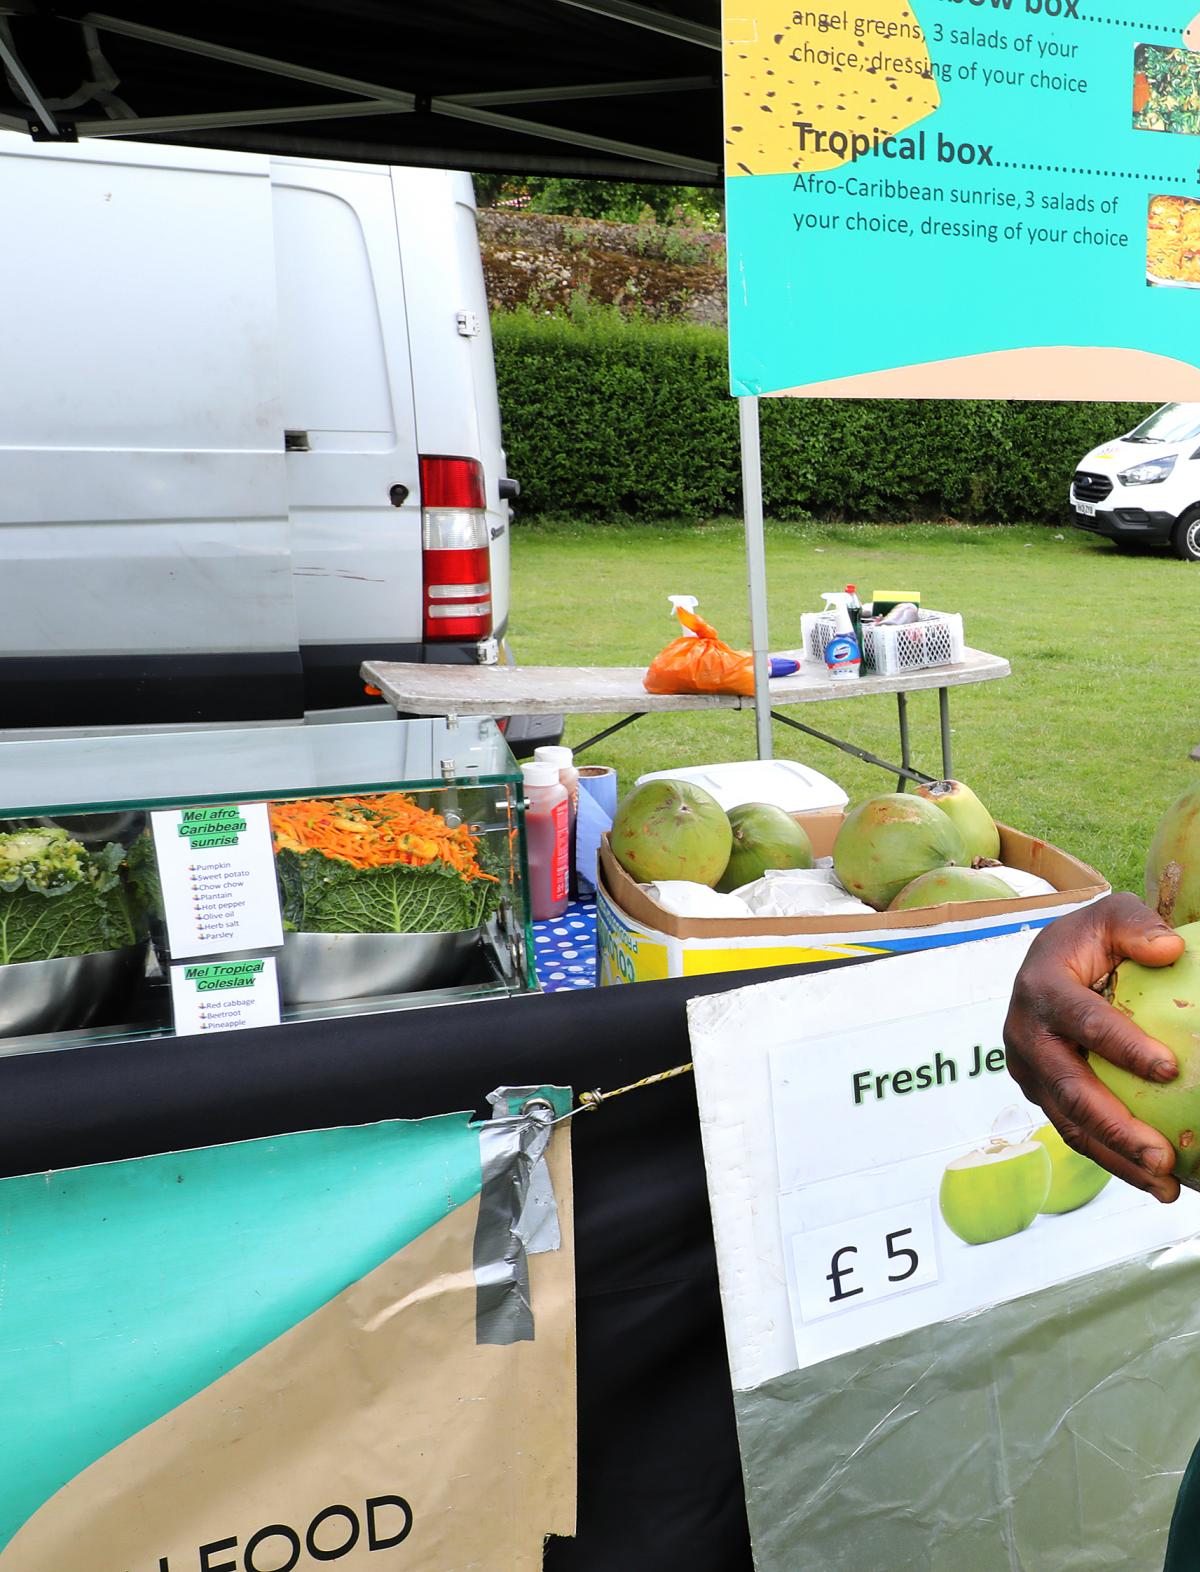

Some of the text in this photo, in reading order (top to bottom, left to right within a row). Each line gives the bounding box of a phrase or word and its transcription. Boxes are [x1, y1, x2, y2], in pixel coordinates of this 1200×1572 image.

[792, 10, 1078, 59] angel greens, 3 salads of your
[792, 43, 1087, 93] choice, dressing of your choice
[792, 122, 925, 163] Tropical
[793, 174, 1118, 214] Afro-Caribbean sunrise, 3 salads of
[793, 211, 1128, 247] your choice, dressing of your choice
[183, 810, 207, 822] Mel
[179, 821, 247, 836] Caribbean
[190, 835, 239, 848] sunrise
[196, 862, 231, 871] Pumpkin
[197, 870, 250, 881] Sweet potato
[199, 883, 221, 891] Chow
[200, 891, 232, 901] Plantain
[201, 900, 246, 910] Hot pepper
[202, 912, 223, 921] Olive
[204, 920, 239, 930] Herb salt
[205, 931, 234, 940] Parsley
[185, 962, 264, 978] Mel Tropical
[197, 977, 256, 990] Coleslaw
[206, 999, 255, 1009] Red cabbage
[207, 1010, 241, 1019] Beetroot
[208, 1020, 246, 1029] Pineapple
[853, 1052, 956, 1104] Fresh
[826, 1227, 919, 1302] £ 5
[199, 1495, 413, 1572] FOOD
